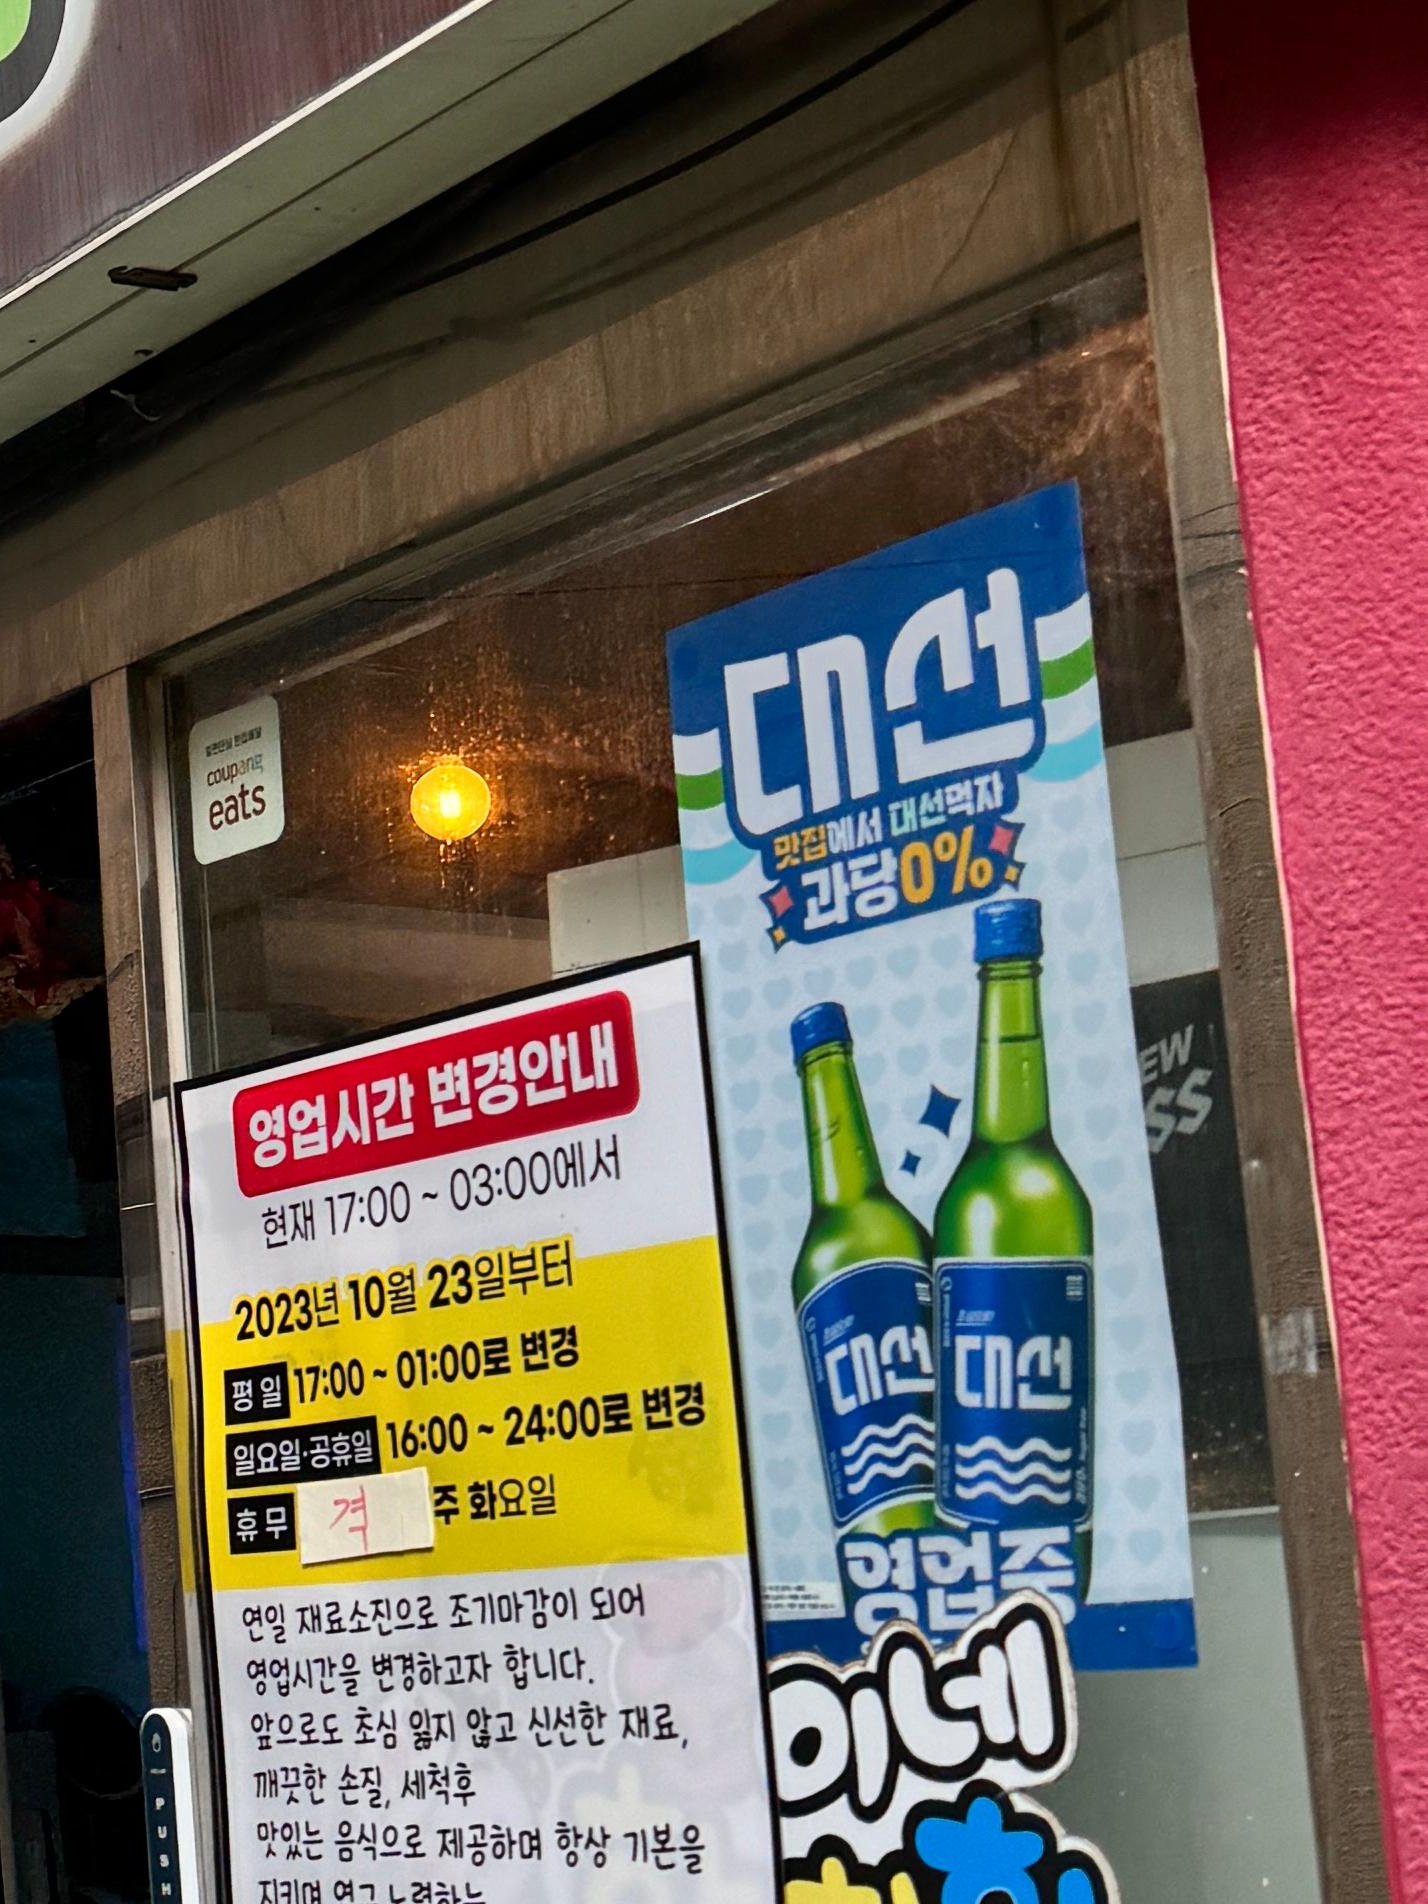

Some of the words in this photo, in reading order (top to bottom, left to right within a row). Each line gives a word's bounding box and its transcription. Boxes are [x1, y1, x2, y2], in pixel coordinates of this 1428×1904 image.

[722, 566, 1037, 836] 대선
[207, 752, 264, 787] coupang
[209, 783, 266, 831] eats
[773, 806, 883, 871] 맛집에서
[888, 770, 1004, 837] 대선먹자
[248, 1073, 415, 1169] 영업시간
[427, 1020, 619, 1129] 변경안내
[260, 1197, 317, 1250] 현재
[324, 1180, 411, 1236] 17:00
[449, 1133, 622, 1212] 03:00에서
[234, 1282, 339, 1343] 2023년
[347, 1268, 417, 1321] 10월
[427, 1239, 574, 1309] 23일부터
[293, 1357, 366, 1404] 17:00
[396, 1336, 512, 1390] 01:00로
[520, 1324, 580, 1373] 변경
[823, 1324, 935, 1416] 대선
[954, 1334, 1073, 1411] 대선
[385, 1411, 469, 1459] 16:00
[503, 1392, 633, 1447] 24:00로
[641, 1381, 707, 1432] 변경
[328, 1483, 369, 1554] 격
[467, 1473, 558, 1522] 화요일
[242, 1601, 287, 1644] 연일
[297, 1596, 440, 1637] 재료소진으로
[448, 1587, 580, 1630] 조기마감이
[590, 1583, 646, 1621] 되어
[246, 1653, 362, 1698] 영업시간을
[371, 1649, 492, 1694] 변경하고자
[504, 1643, 595, 1690] 합니다.
[250, 1710, 344, 1751] 앞으로도
[354, 1705, 398, 1750] 초심
[466, 1706, 519, 1750] 않고
[528, 1700, 608, 1749] 신선한
[618, 1702, 689, 1751] 재료,
[254, 1763, 327, 1807] 깨끗한
[338, 1763, 391, 1810] 손질,
[400, 1761, 477, 1807] 세척후
[154, 1797, 173, 1896] PUSH
[256, 1821, 324, 1861] 맛있는
[334, 1821, 427, 1863] 음식으로
[437, 1826, 544, 1867] 제공하며
[555, 1821, 612, 1869] 항상
[624, 1822, 707, 1876] 기본을
